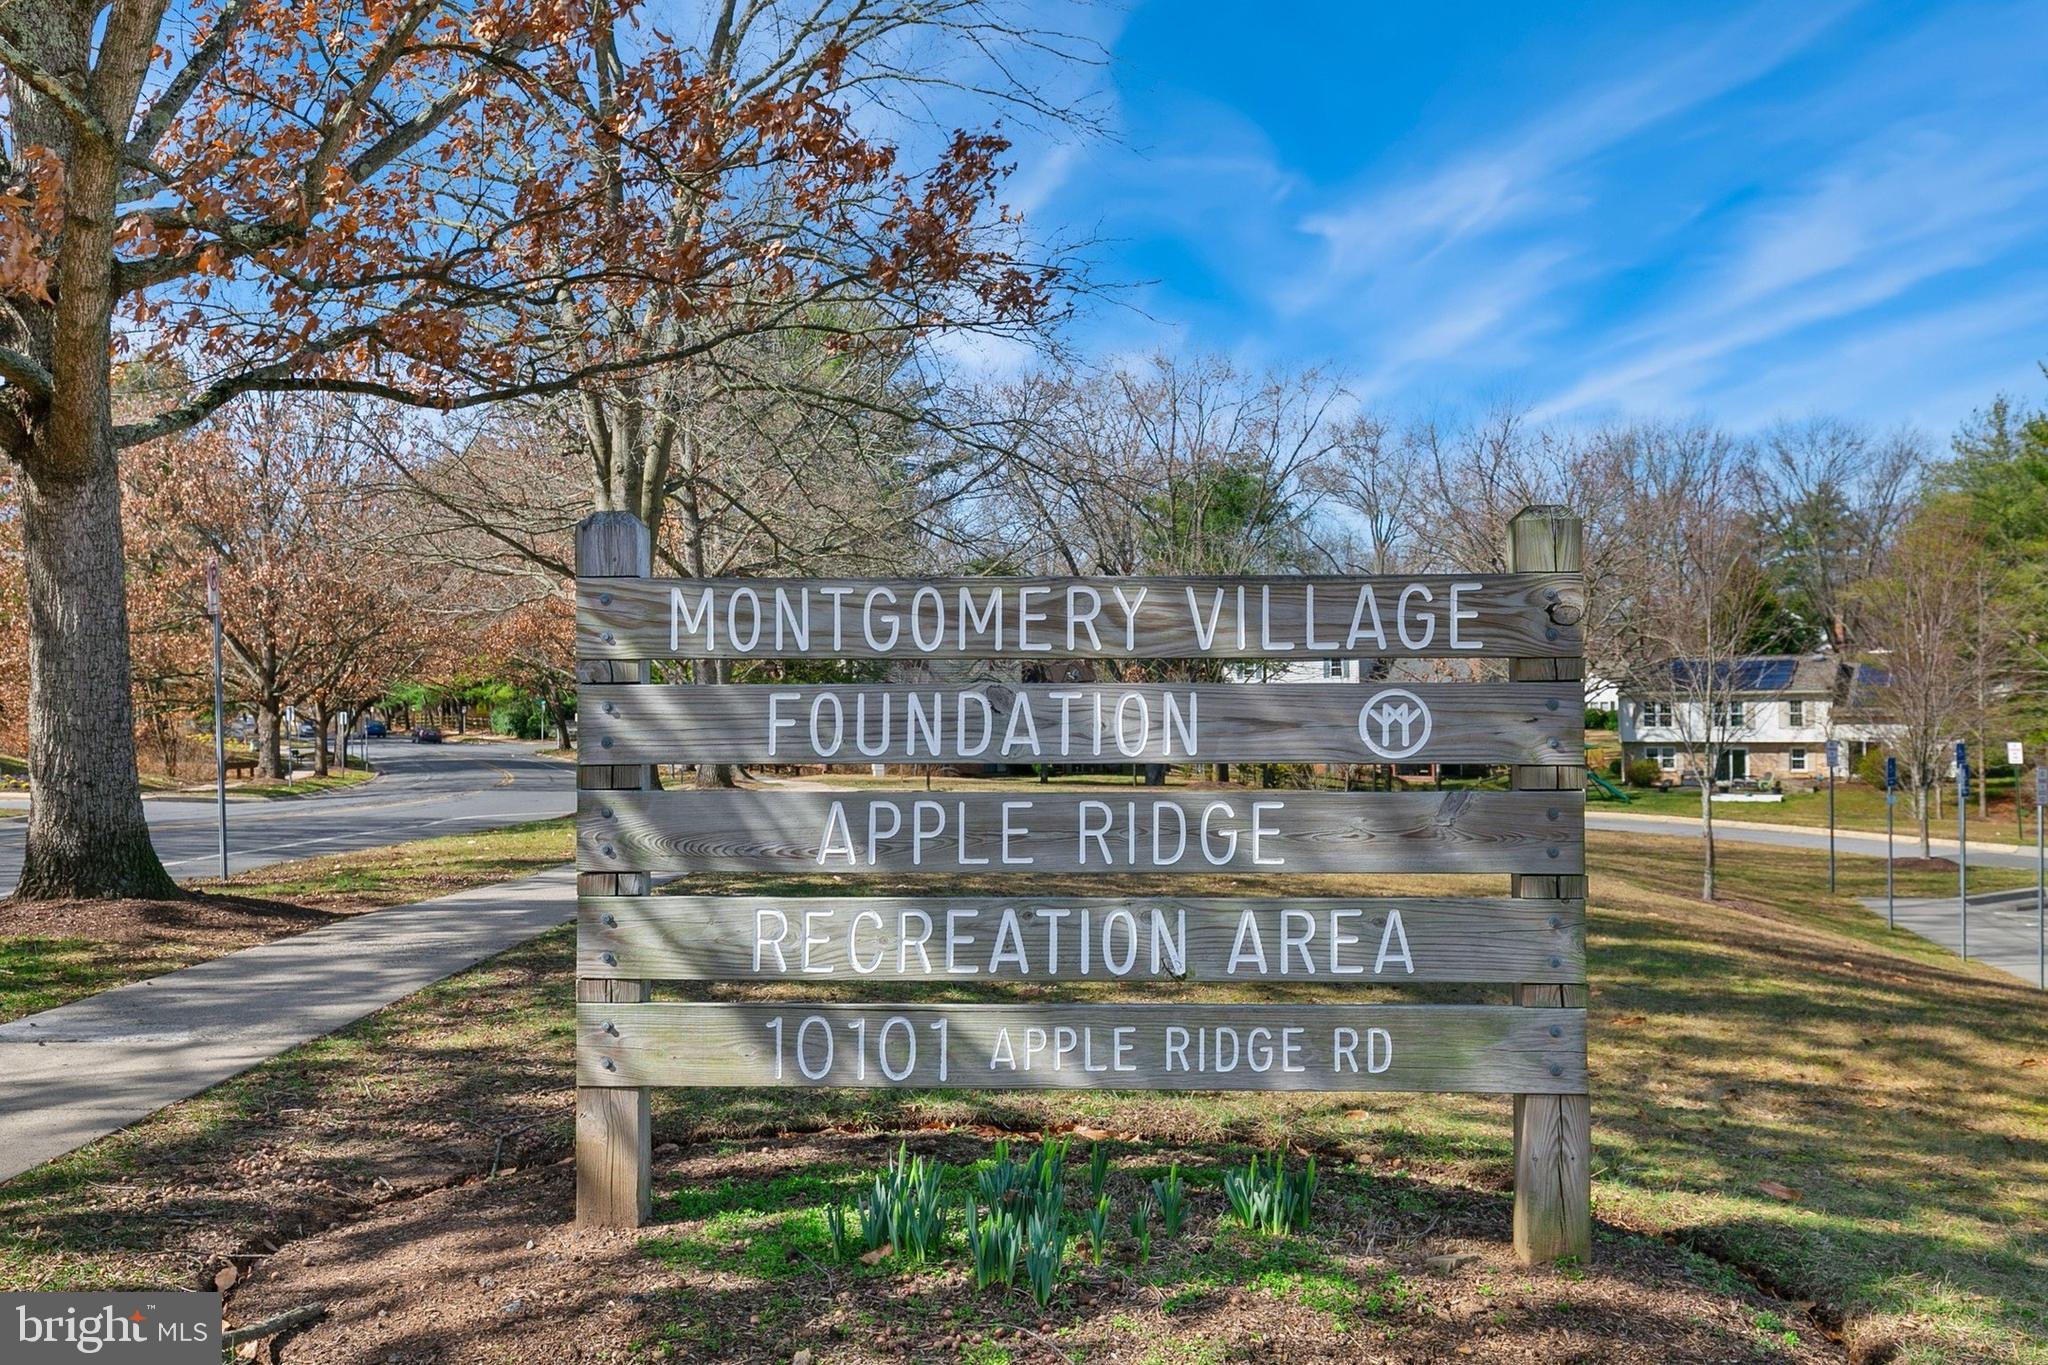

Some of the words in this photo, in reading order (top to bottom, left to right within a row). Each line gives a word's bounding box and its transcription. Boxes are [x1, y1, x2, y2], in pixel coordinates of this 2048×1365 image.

[669, 586, 1148, 652] MONTGOMERY
[1185, 582, 1484, 651] VILLAGE
[768, 691, 1198, 758] FOUNDATION
[816, 801, 1034, 866] APPLE
[1079, 801, 1286, 866] RIDGE
[752, 908, 1187, 976] RECREATION
[1227, 908, 1415, 975] AREA
[765, 1015, 948, 1082] 10101
[989, 1026, 1137, 1073] APPLE
[1165, 1026, 1306, 1073] RIDGE
[1333, 1027, 1394, 1074] RD
